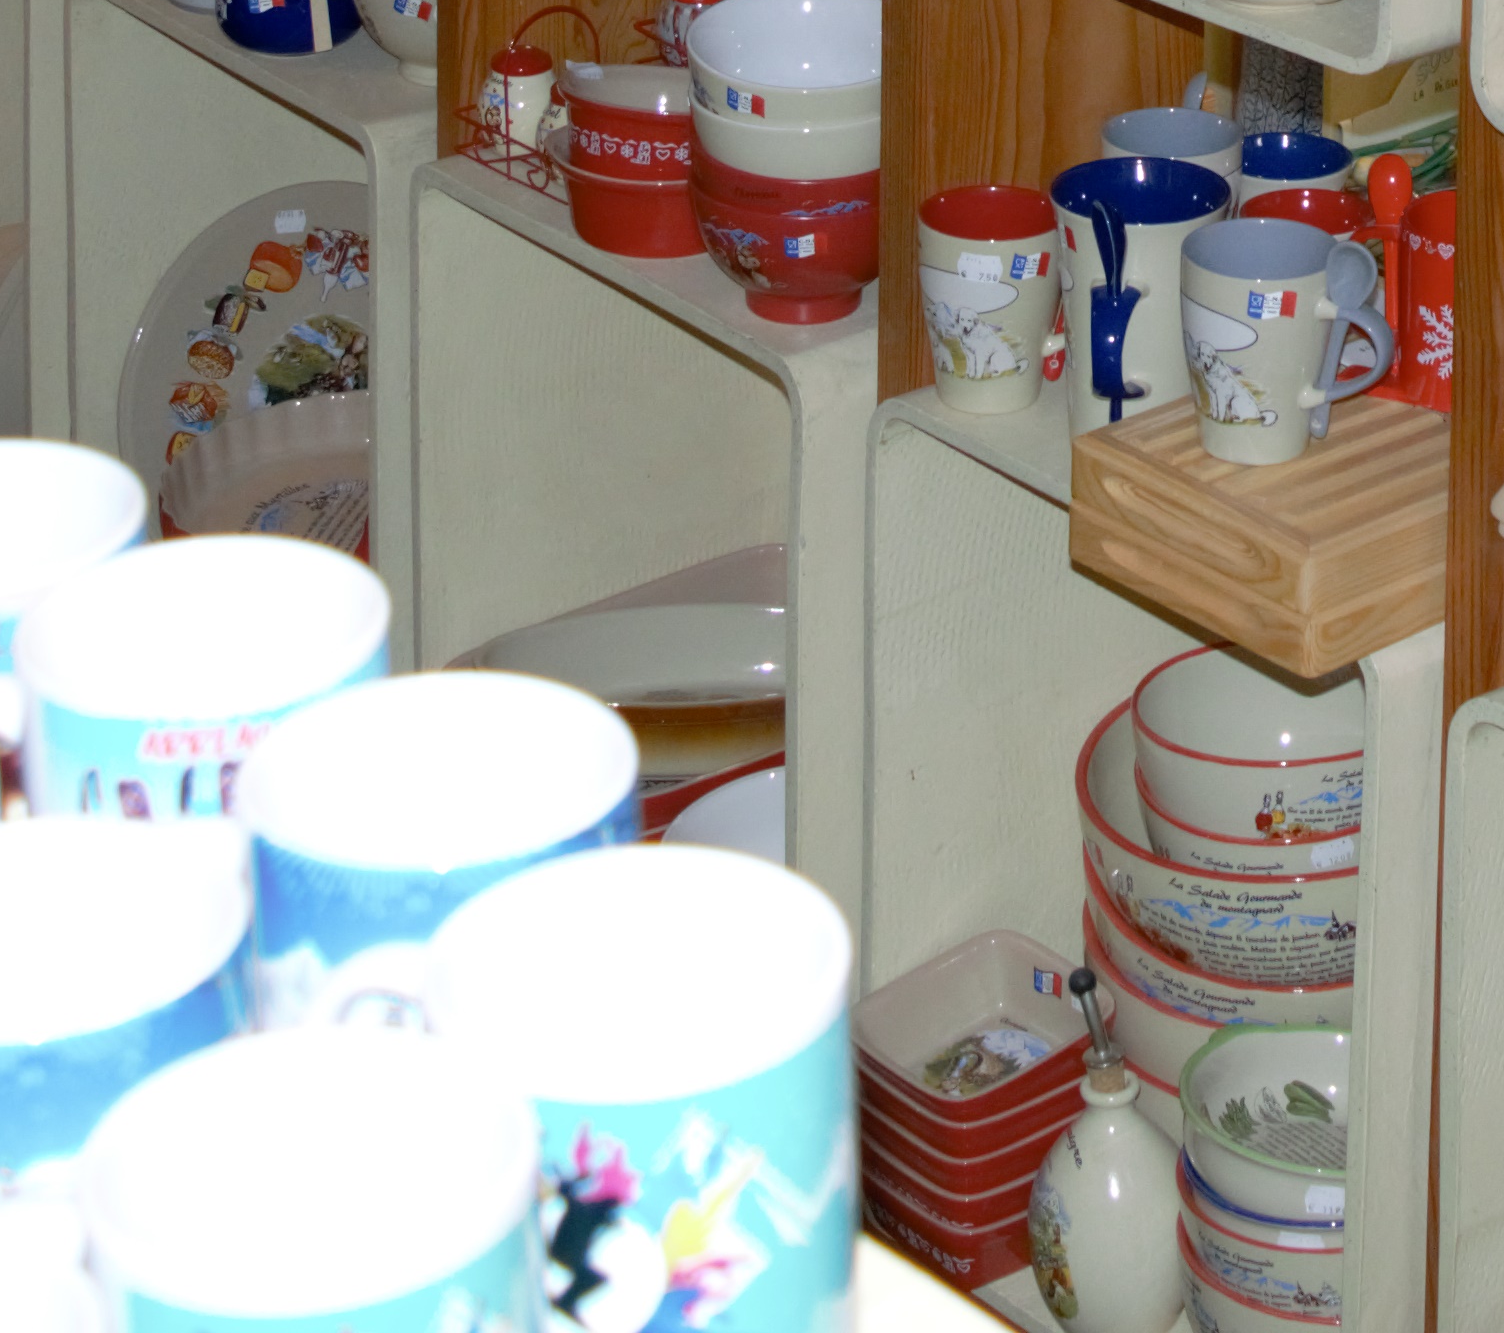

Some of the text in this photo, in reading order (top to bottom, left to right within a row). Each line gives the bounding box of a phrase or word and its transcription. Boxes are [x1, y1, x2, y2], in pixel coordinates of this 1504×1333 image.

[1187, 885, 1304, 905] Salade Gourmande
[1218, 904, 1284, 917] montagnard
[1152, 969, 1256, 1007] Salade Gourmande
